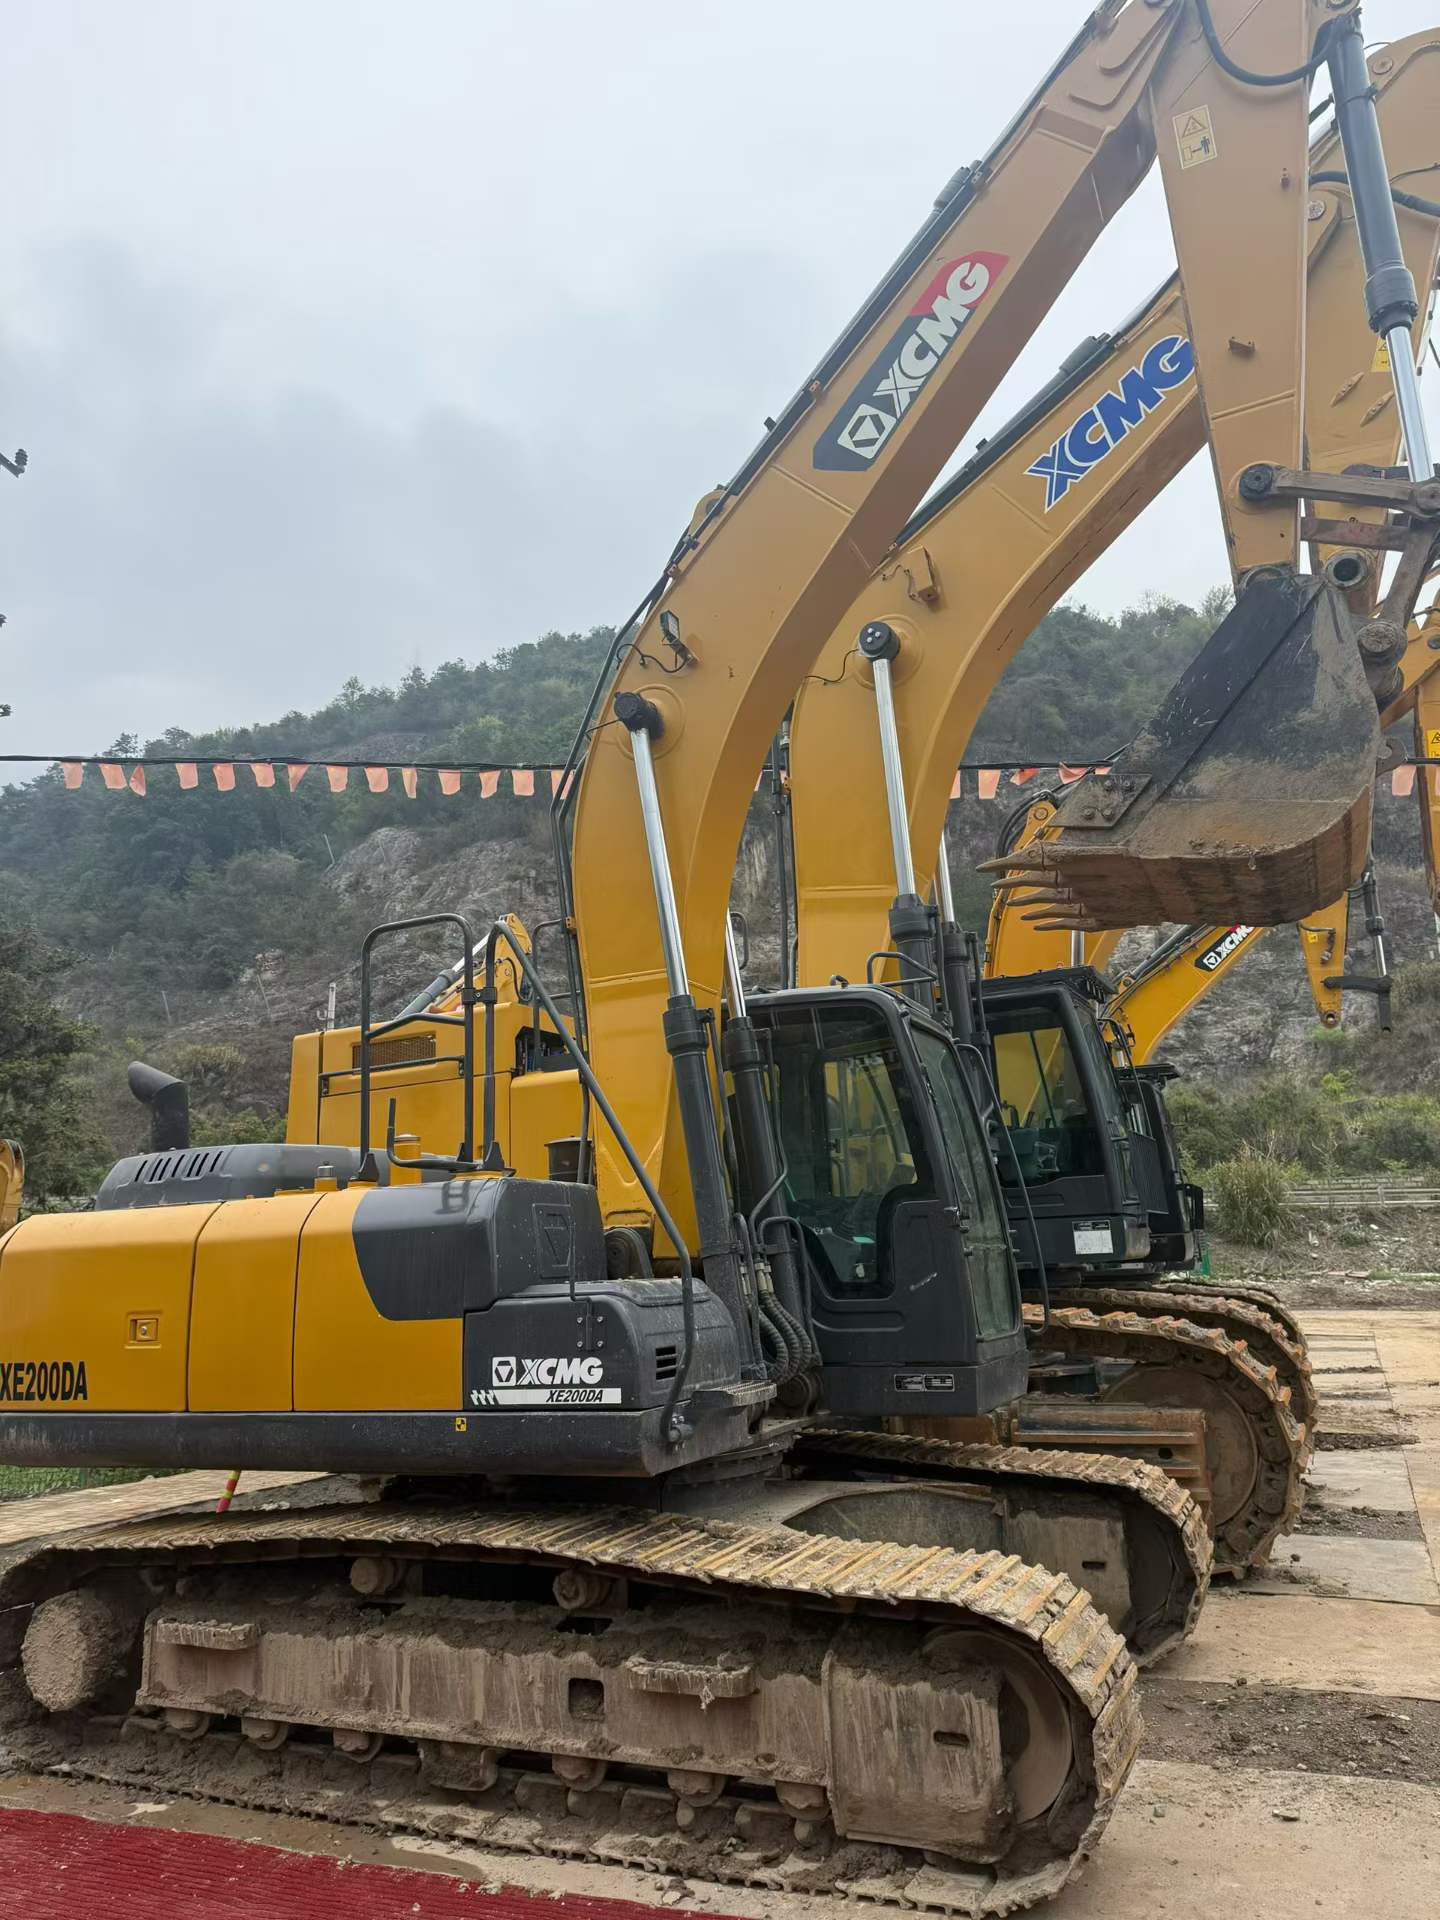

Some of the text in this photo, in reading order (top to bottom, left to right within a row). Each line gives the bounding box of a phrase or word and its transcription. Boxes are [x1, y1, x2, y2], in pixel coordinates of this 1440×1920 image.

[872, 261, 990, 419] XCMG
[1023, 335, 1196, 513] XCMG
[0, 1361, 88, 1401] XE200DA
[516, 1357, 604, 1385] XCMG
[546, 1390, 603, 1403] XE200DA
